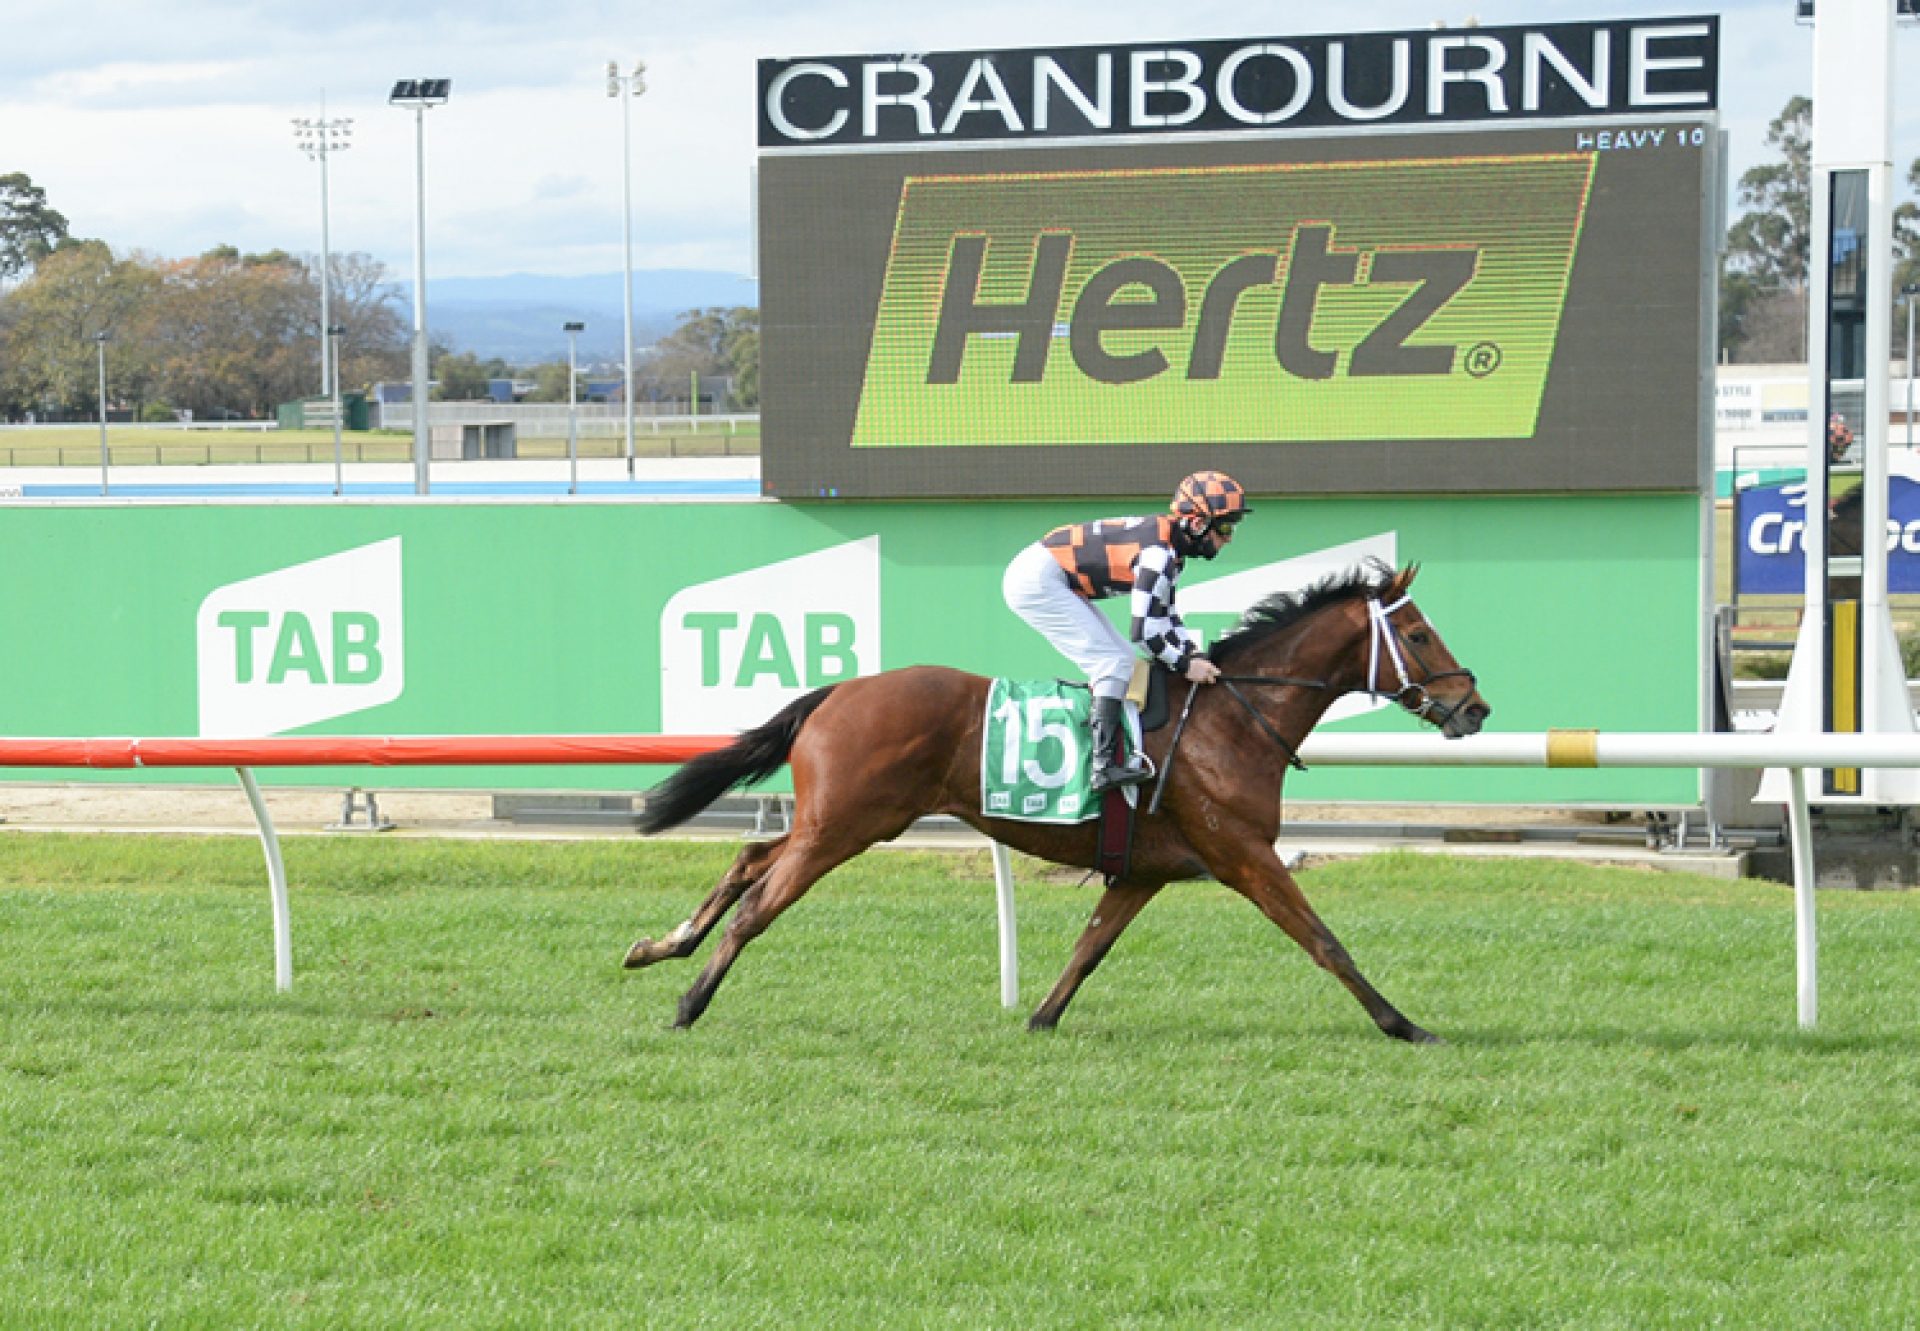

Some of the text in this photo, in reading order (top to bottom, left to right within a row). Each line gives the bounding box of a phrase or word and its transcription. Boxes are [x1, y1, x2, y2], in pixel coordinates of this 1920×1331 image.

[766, 24, 1709, 140] CRANBOURNE
[1576, 127, 1705, 151] HEAVY 10
[925, 223, 1480, 385] Hertz
[217, 610, 383, 686] TAB
[681, 611, 859, 688] TAB
[992, 695, 1079, 789] 15
